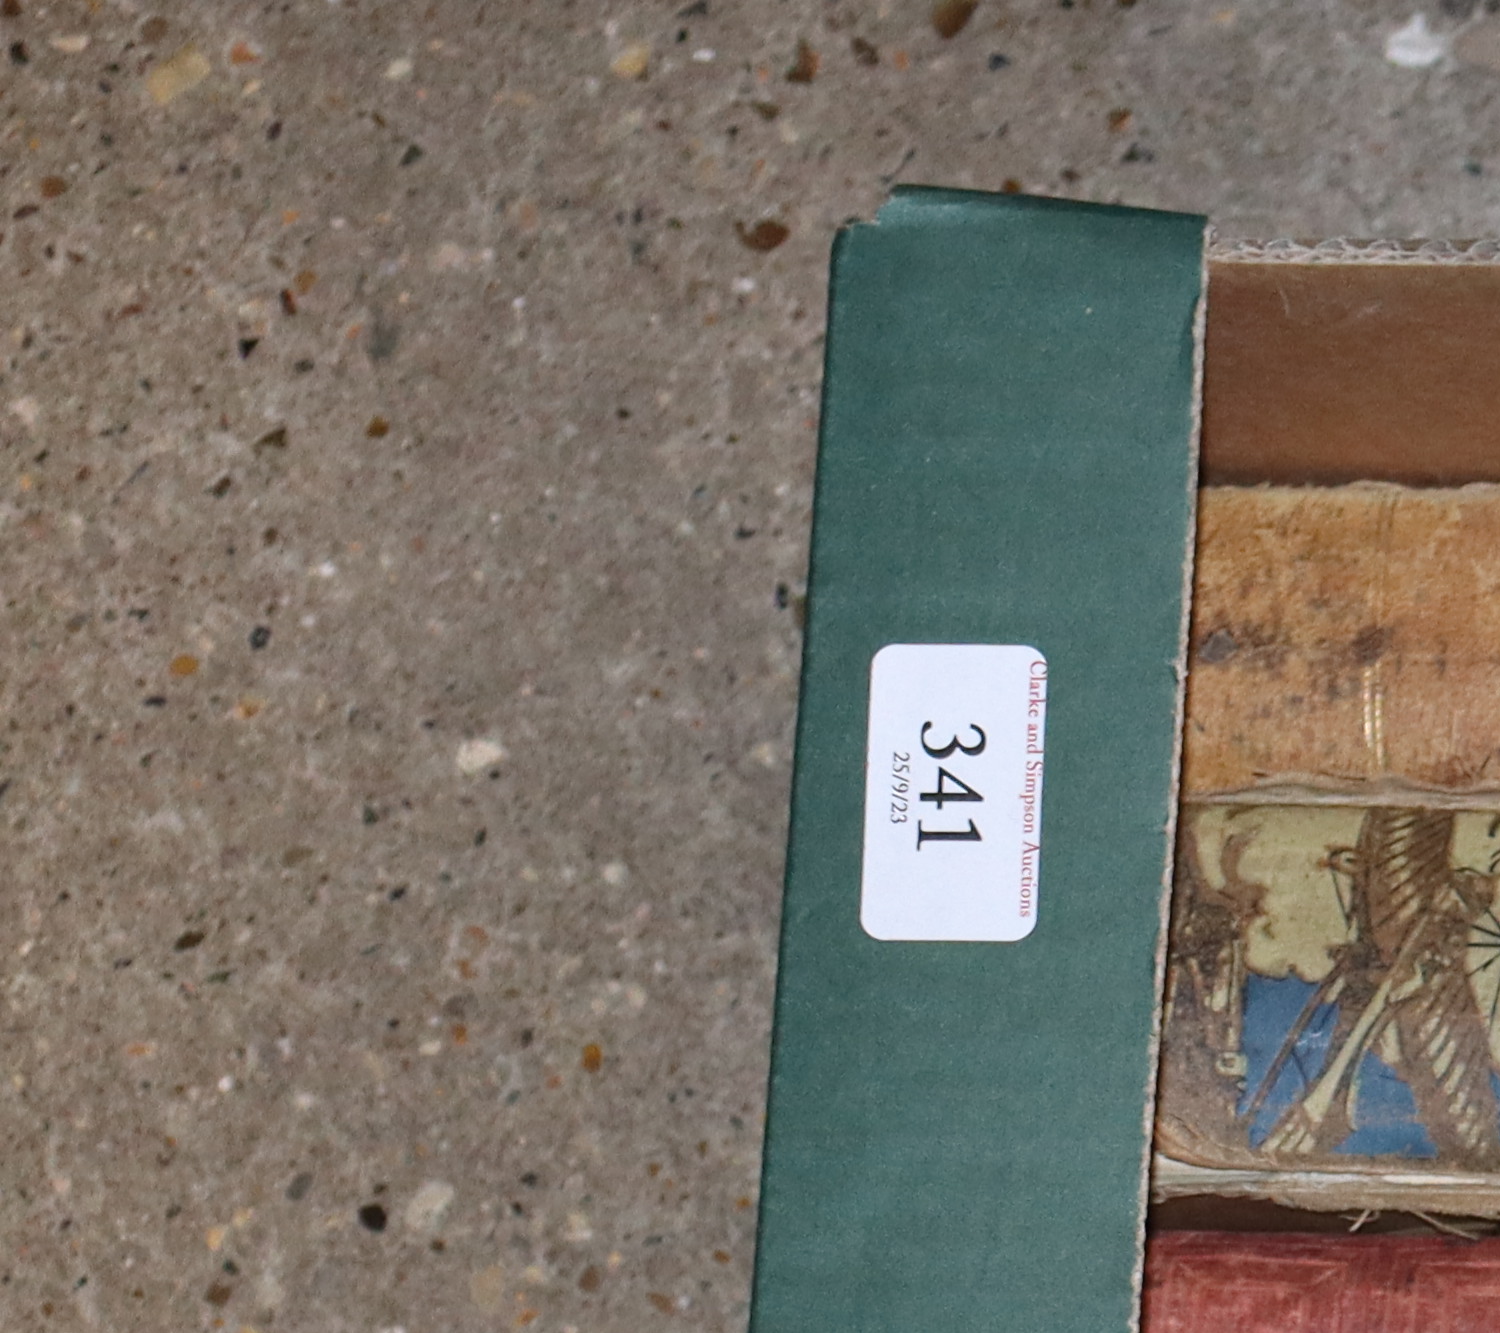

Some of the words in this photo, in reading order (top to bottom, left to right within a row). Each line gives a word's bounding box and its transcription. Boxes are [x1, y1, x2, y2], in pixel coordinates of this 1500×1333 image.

[1028, 660, 1048, 718] Clarke
[1026, 723, 1044, 755] and
[890, 751, 911, 825] 25/9/23
[916, 720, 987, 851] 341
[1019, 760, 1044, 834] Simpson
[1019, 840, 1041, 918] Auctions
